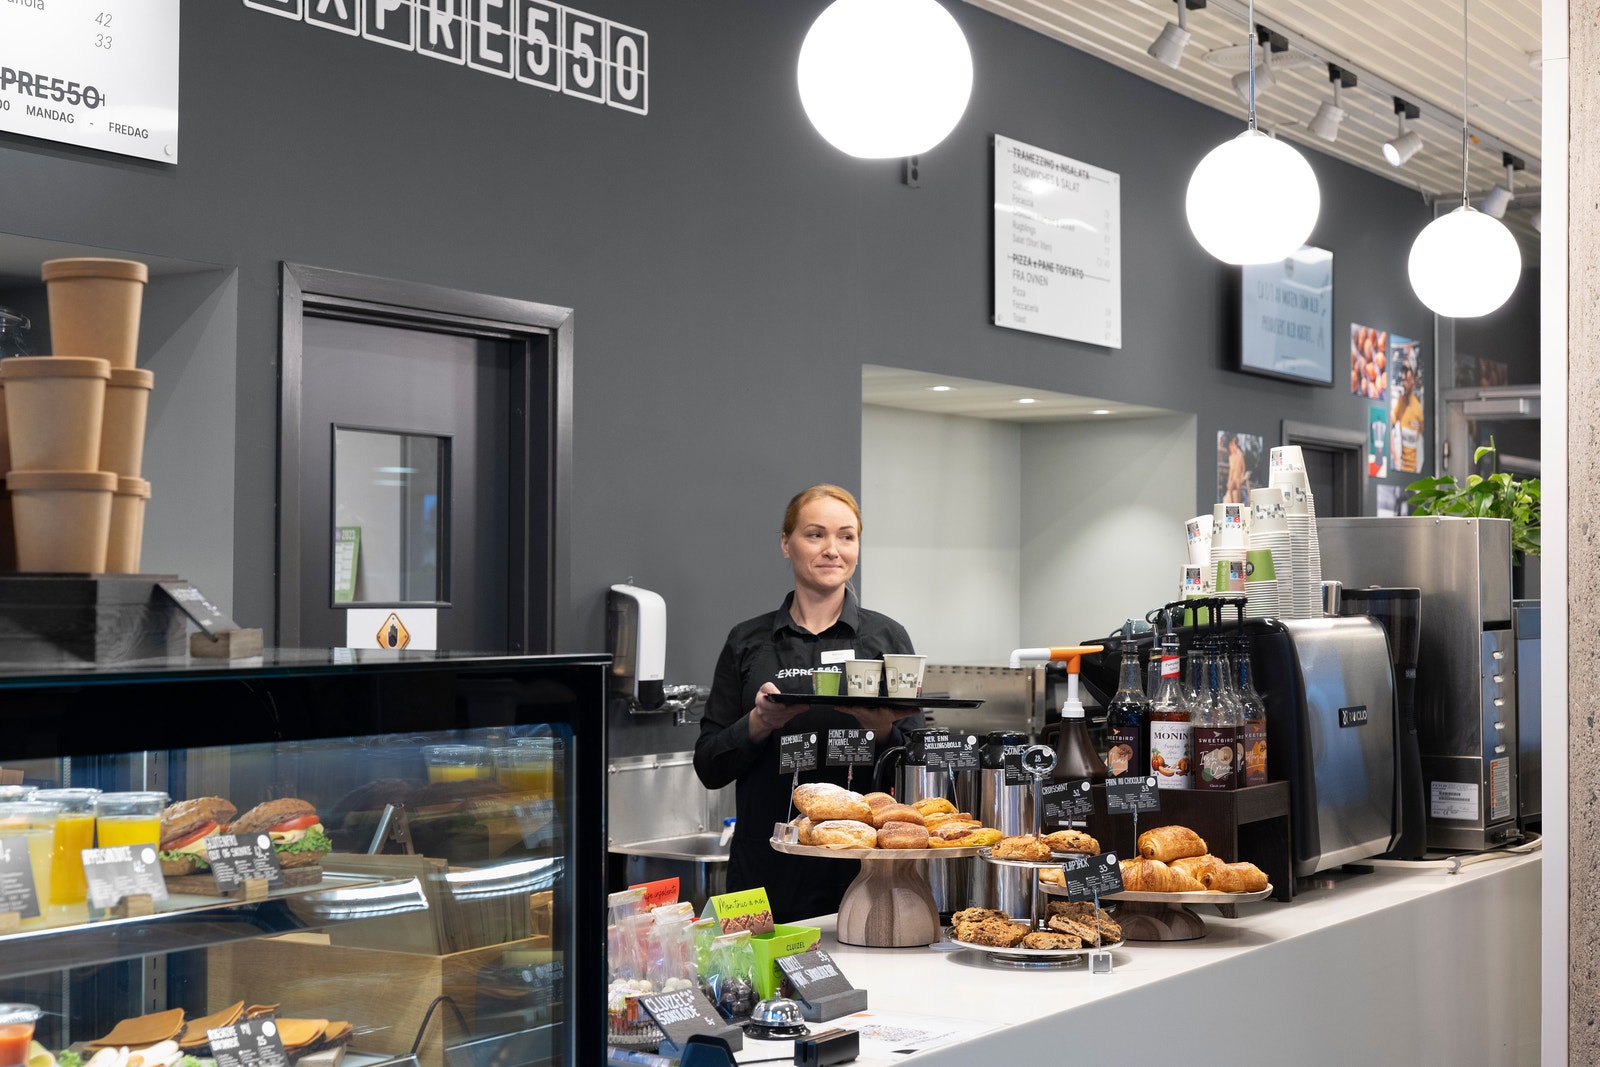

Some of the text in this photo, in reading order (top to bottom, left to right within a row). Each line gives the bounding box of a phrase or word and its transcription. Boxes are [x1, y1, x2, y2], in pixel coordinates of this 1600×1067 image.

[95, 12, 113, 28] 42
[95, 34, 113, 50] 33
[26, 105, 75, 124] MANDAG
[109, 122, 149, 139] FREDAG
[1013, 253, 1032, 267] PIZZA
[1038, 259, 1055, 273] PANE
[1056, 264, 1085, 280] TOSTATO
[1013, 269, 1049, 287] FRA OVNEN
[829, 730, 859, 739] HONEY BUN
[1154, 732, 1189, 740] MONIN
[924, 742, 962, 750] SKILLINGSBOLLE
[1105, 778, 1117, 787] PAIN
[1124, 776, 1146, 785] CHOCOLAT
[1042, 783, 1069, 795] CROISSANT
[1098, 864, 1109, 873] 33
[786, 942, 805, 952] CLUIZEL
[645, 992, 689, 1014] CLUIZEL
[656, 1005, 701, 1026] SJOKOLADE
